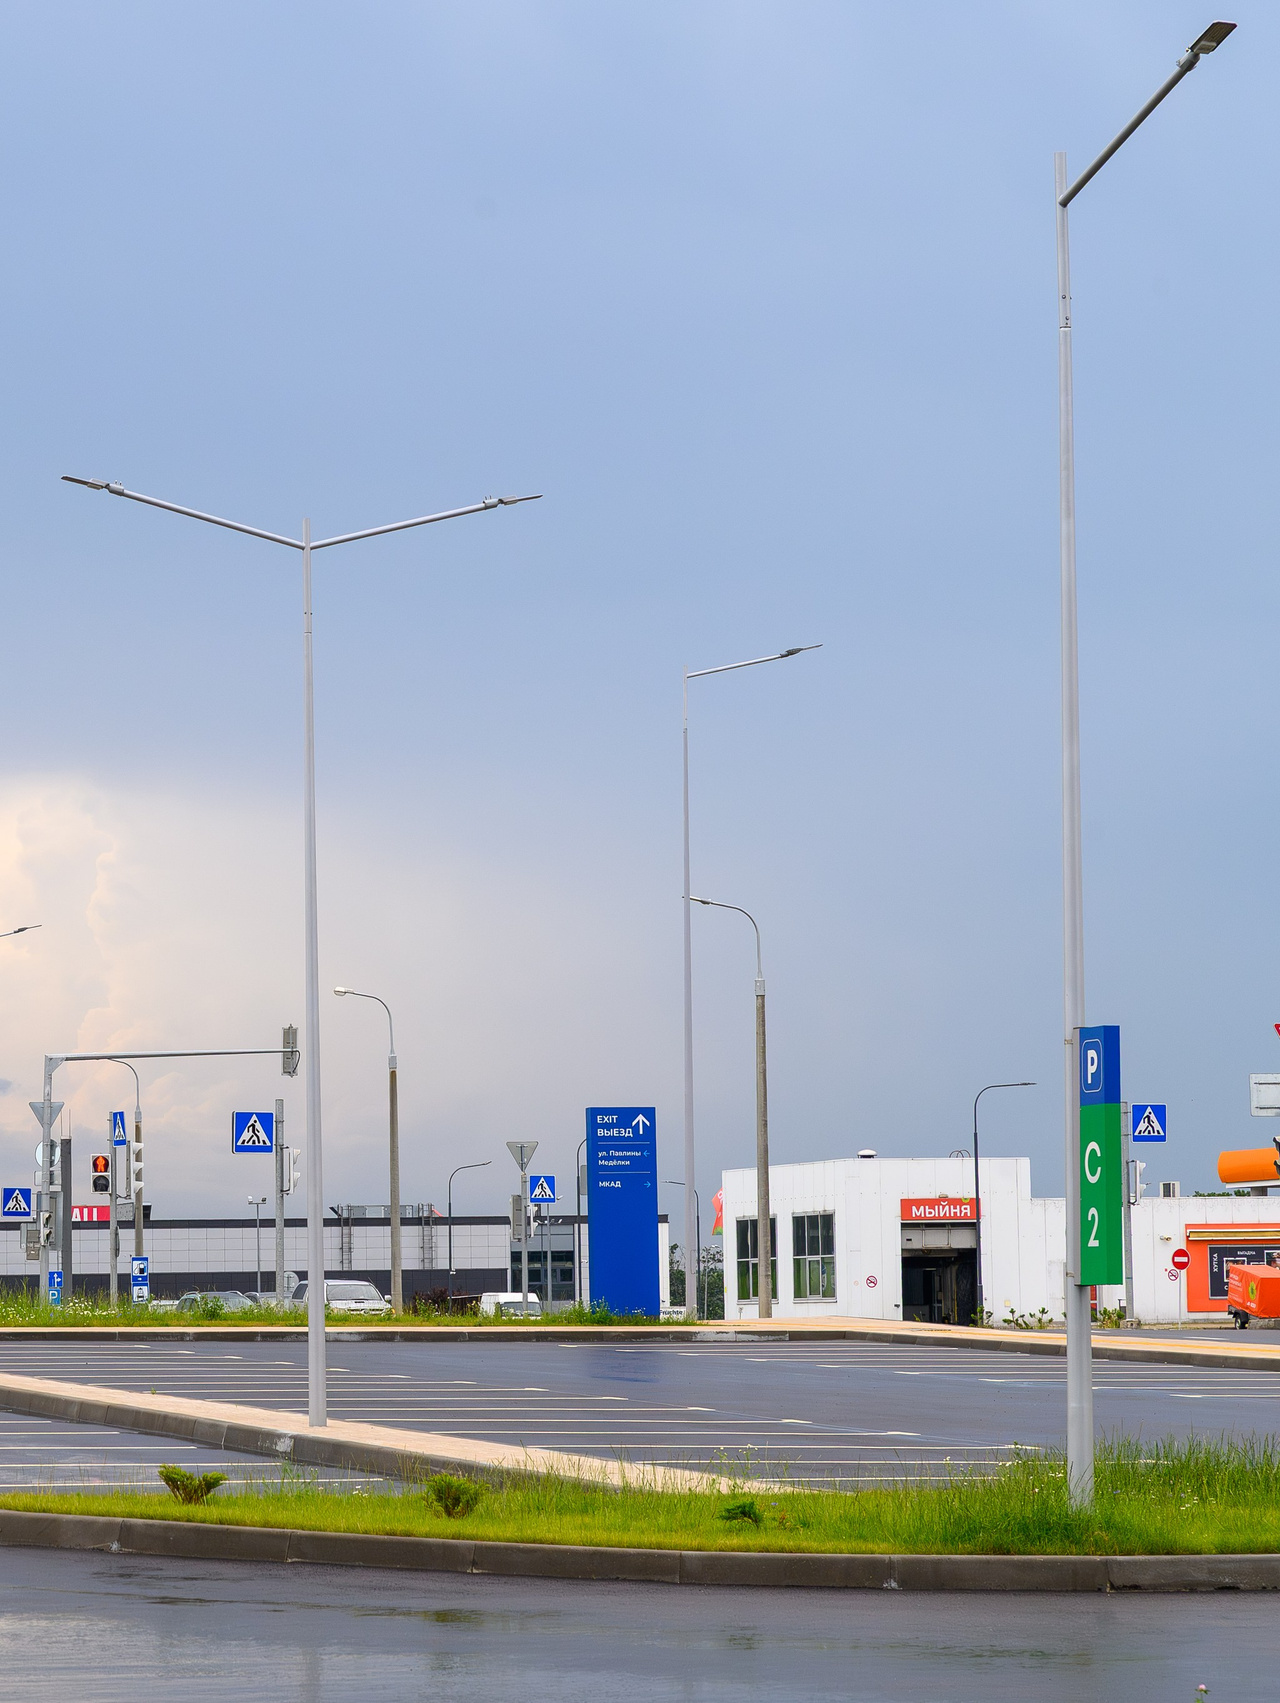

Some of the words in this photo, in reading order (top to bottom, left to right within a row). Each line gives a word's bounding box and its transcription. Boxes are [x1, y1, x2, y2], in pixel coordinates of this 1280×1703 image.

[1087, 1049, 1098, 1084] P
[597, 1115, 618, 1123] EXIT
[597, 1128, 633, 1137] ВЫЕЗД
[911, 1201, 971, 1218] МЫЙНЯ
[1087, 1207, 1100, 1247] 2
